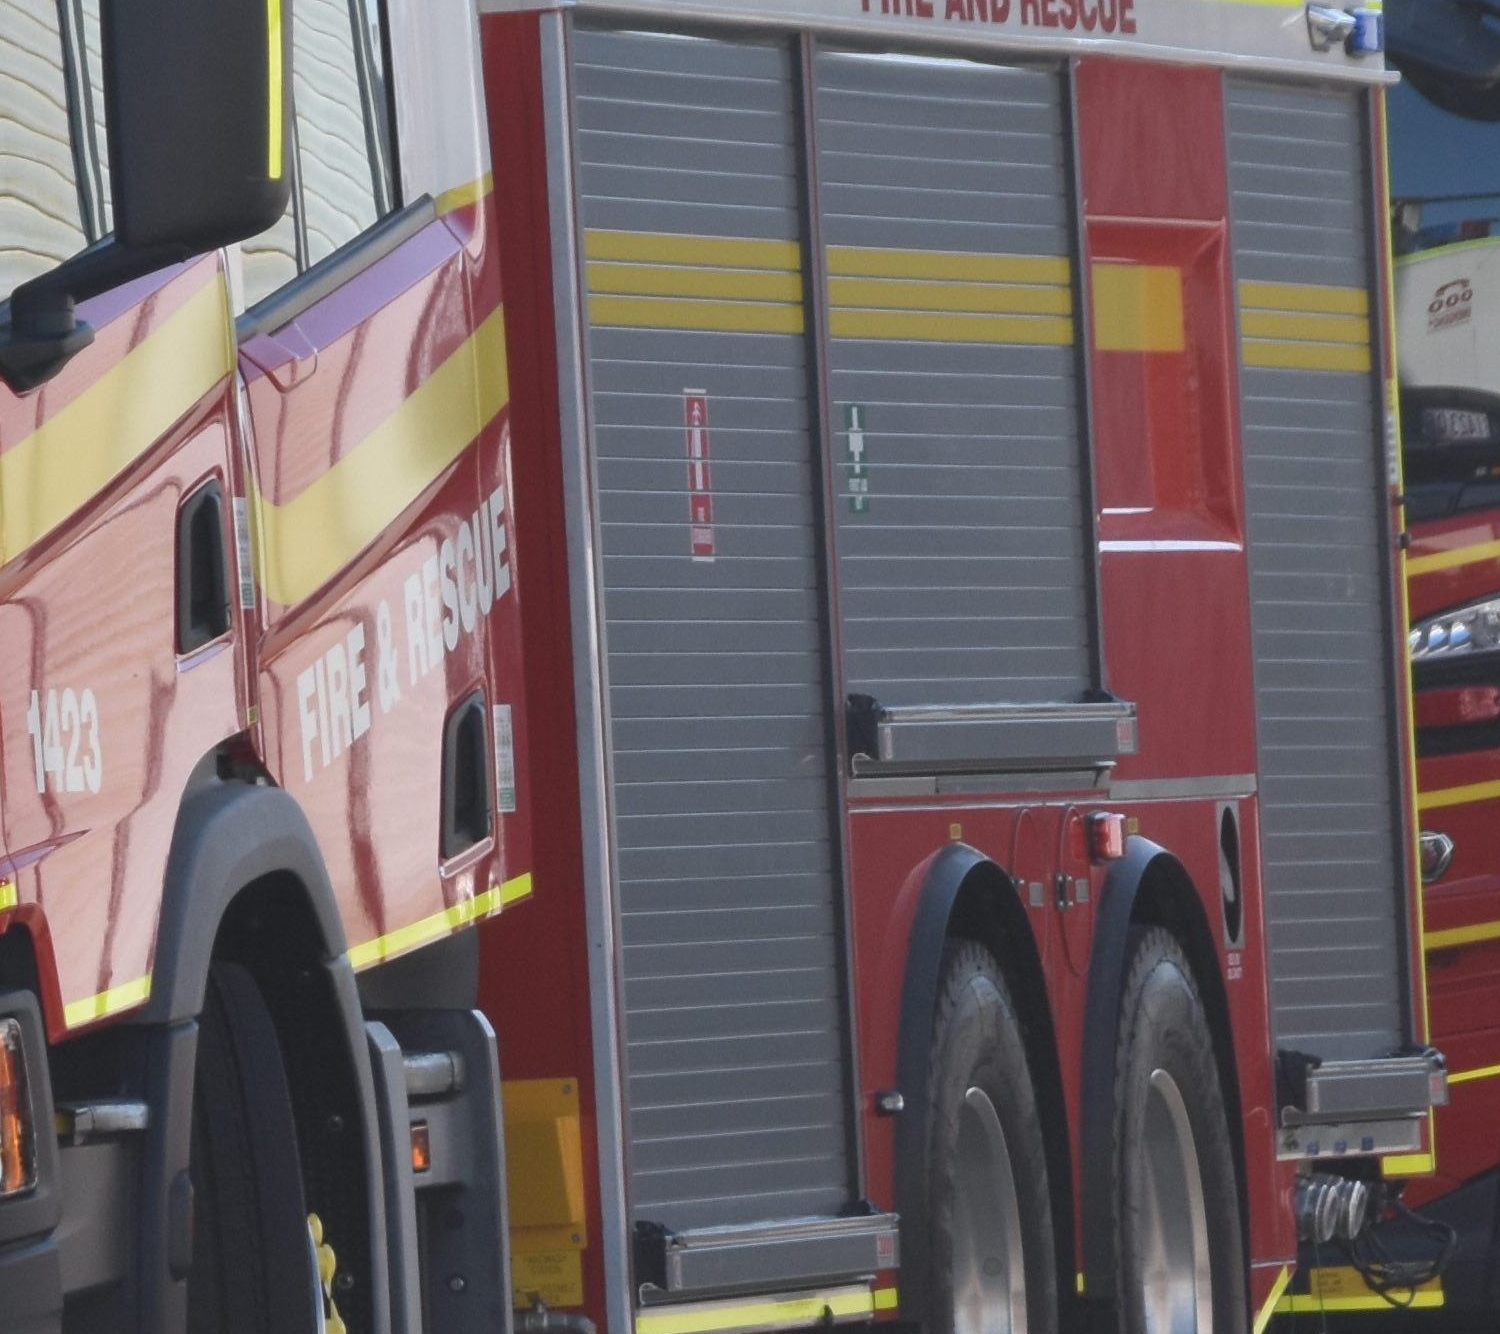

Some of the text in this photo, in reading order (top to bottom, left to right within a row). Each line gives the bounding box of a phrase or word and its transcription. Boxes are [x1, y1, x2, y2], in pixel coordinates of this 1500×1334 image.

[297, 620, 374, 784] FIRE
[376, 613, 402, 709] &
[404, 484, 512, 688] RESCUE
[26, 687, 102, 795] 1423
